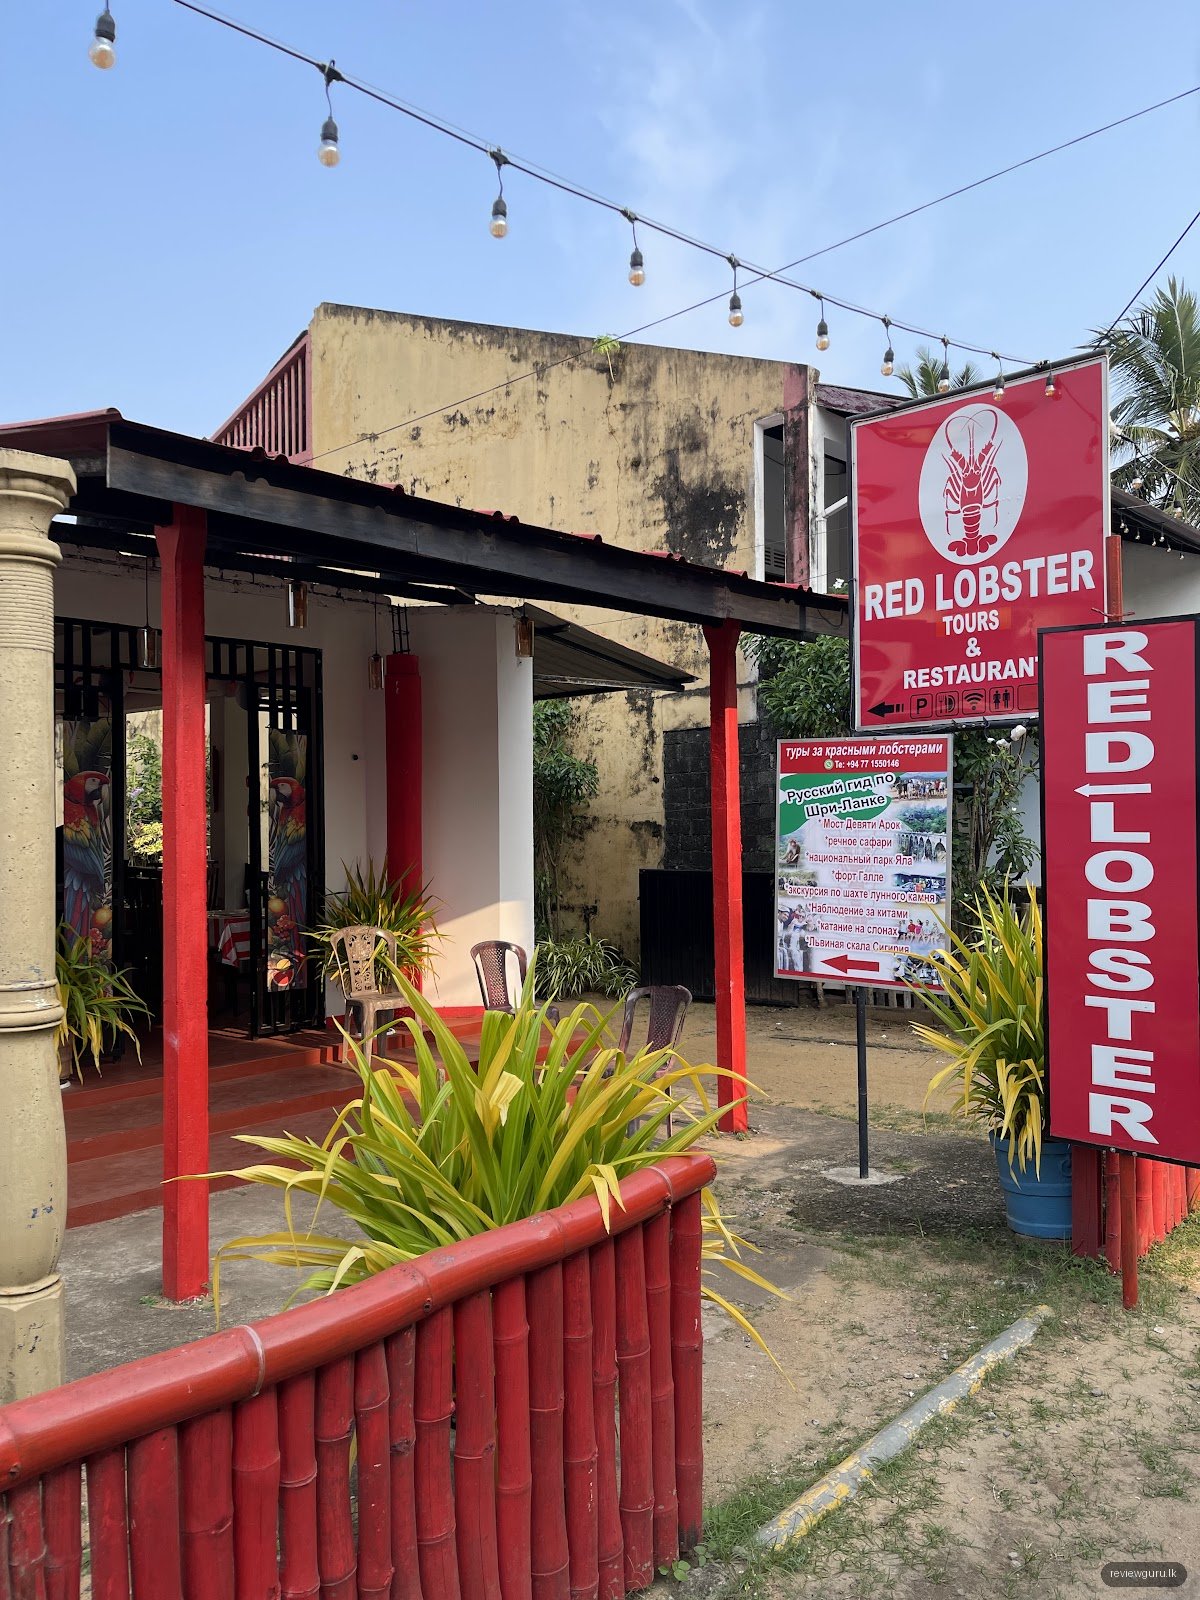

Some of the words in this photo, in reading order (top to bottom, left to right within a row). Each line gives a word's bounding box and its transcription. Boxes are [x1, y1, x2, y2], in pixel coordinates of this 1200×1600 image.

[865, 578, 924, 621] RED
[936, 550, 1095, 611] LOBSTER
[943, 610, 999, 635] TOURS
[966, 638, 981, 658] &
[1083, 630, 1155, 774] RED
[786, 748, 809, 759] туры
[812, 747, 822, 756] за
[825, 745, 875, 758] красными
[878, 742, 942, 757] лобстерами
[846, 760, 859, 768] +94
[787, 783, 843, 802] Русский
[848, 778, 872, 792] гид
[876, 775, 893, 785] по
[806, 795, 885, 817] Шри-Ланке
[823, 819, 844, 829] Мост
[846, 820, 876, 830] Девяти
[879, 820, 900, 832] Арок
[828, 837, 857, 847] речное
[860, 836, 892, 848] сафари
[809, 853, 871, 864] национальный
[874, 856, 893, 866] парк
[896, 856, 912, 865] Яла
[835, 871, 856, 882] форт
[858, 871, 883, 881] Галле
[788, 886, 828, 897] экскурсия
[831, 889, 840, 897] по
[844, 890, 868, 898] шахте
[871, 891, 905, 902] лунного
[908, 894, 935, 902] камня
[811, 903, 863, 916] Наблюдение
[866, 908, 875, 916] за
[877, 910, 908, 918] китами
[820, 923, 853, 932] катание
[855, 925, 864, 933] на
[867, 927, 898, 935] слонах
[809, 937, 844, 948] Львиная
[847, 941, 870, 950] скала
[1084, 801, 1159, 1145] LOBSTER
